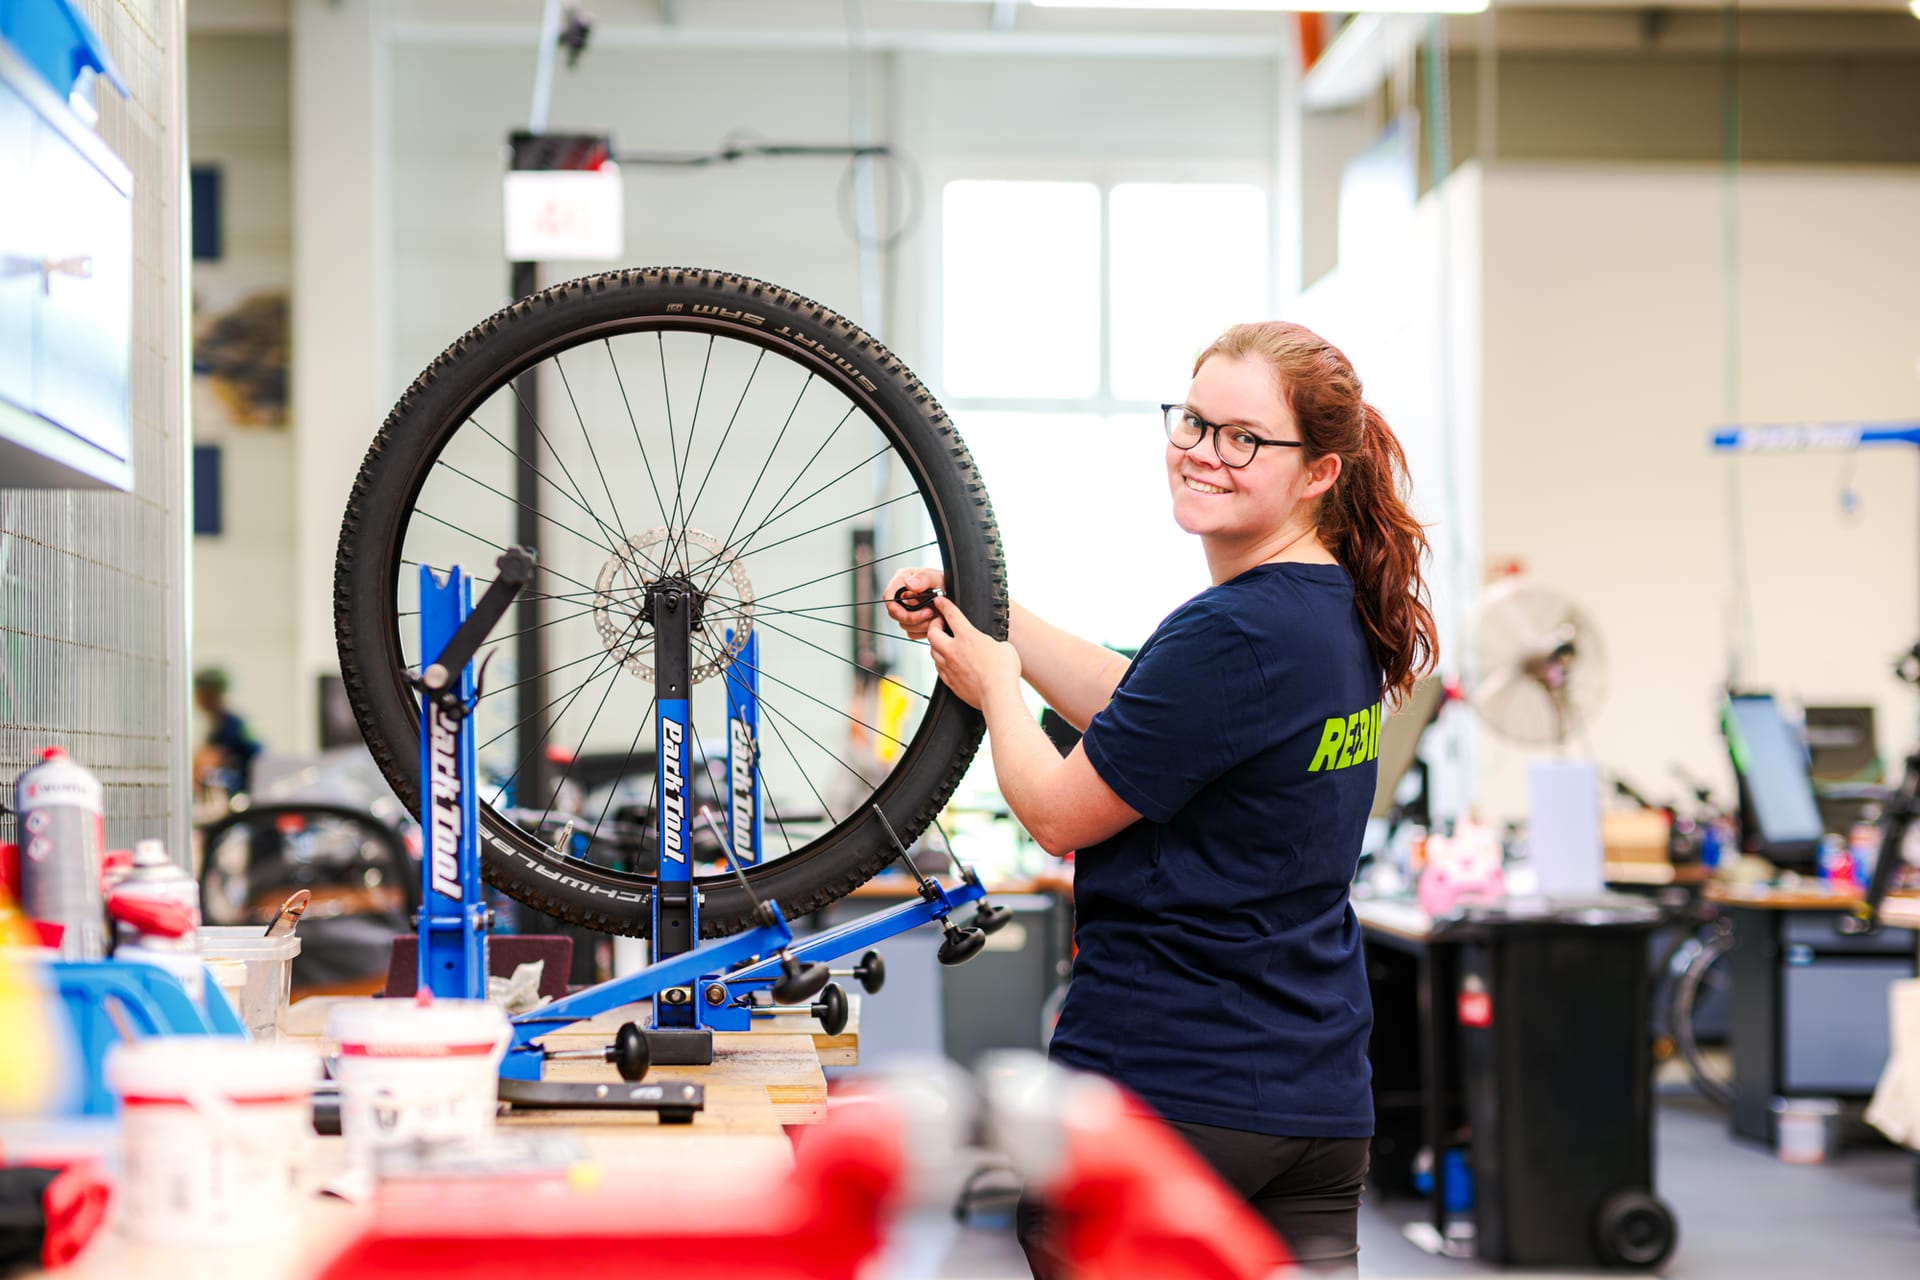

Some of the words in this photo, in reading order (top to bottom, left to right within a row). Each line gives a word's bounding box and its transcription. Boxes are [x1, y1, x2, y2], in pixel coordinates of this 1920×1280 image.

[692, 304, 766, 326] SAM
[773, 326, 878, 392] SMART
[478, 823, 649, 904] CHWALBE
